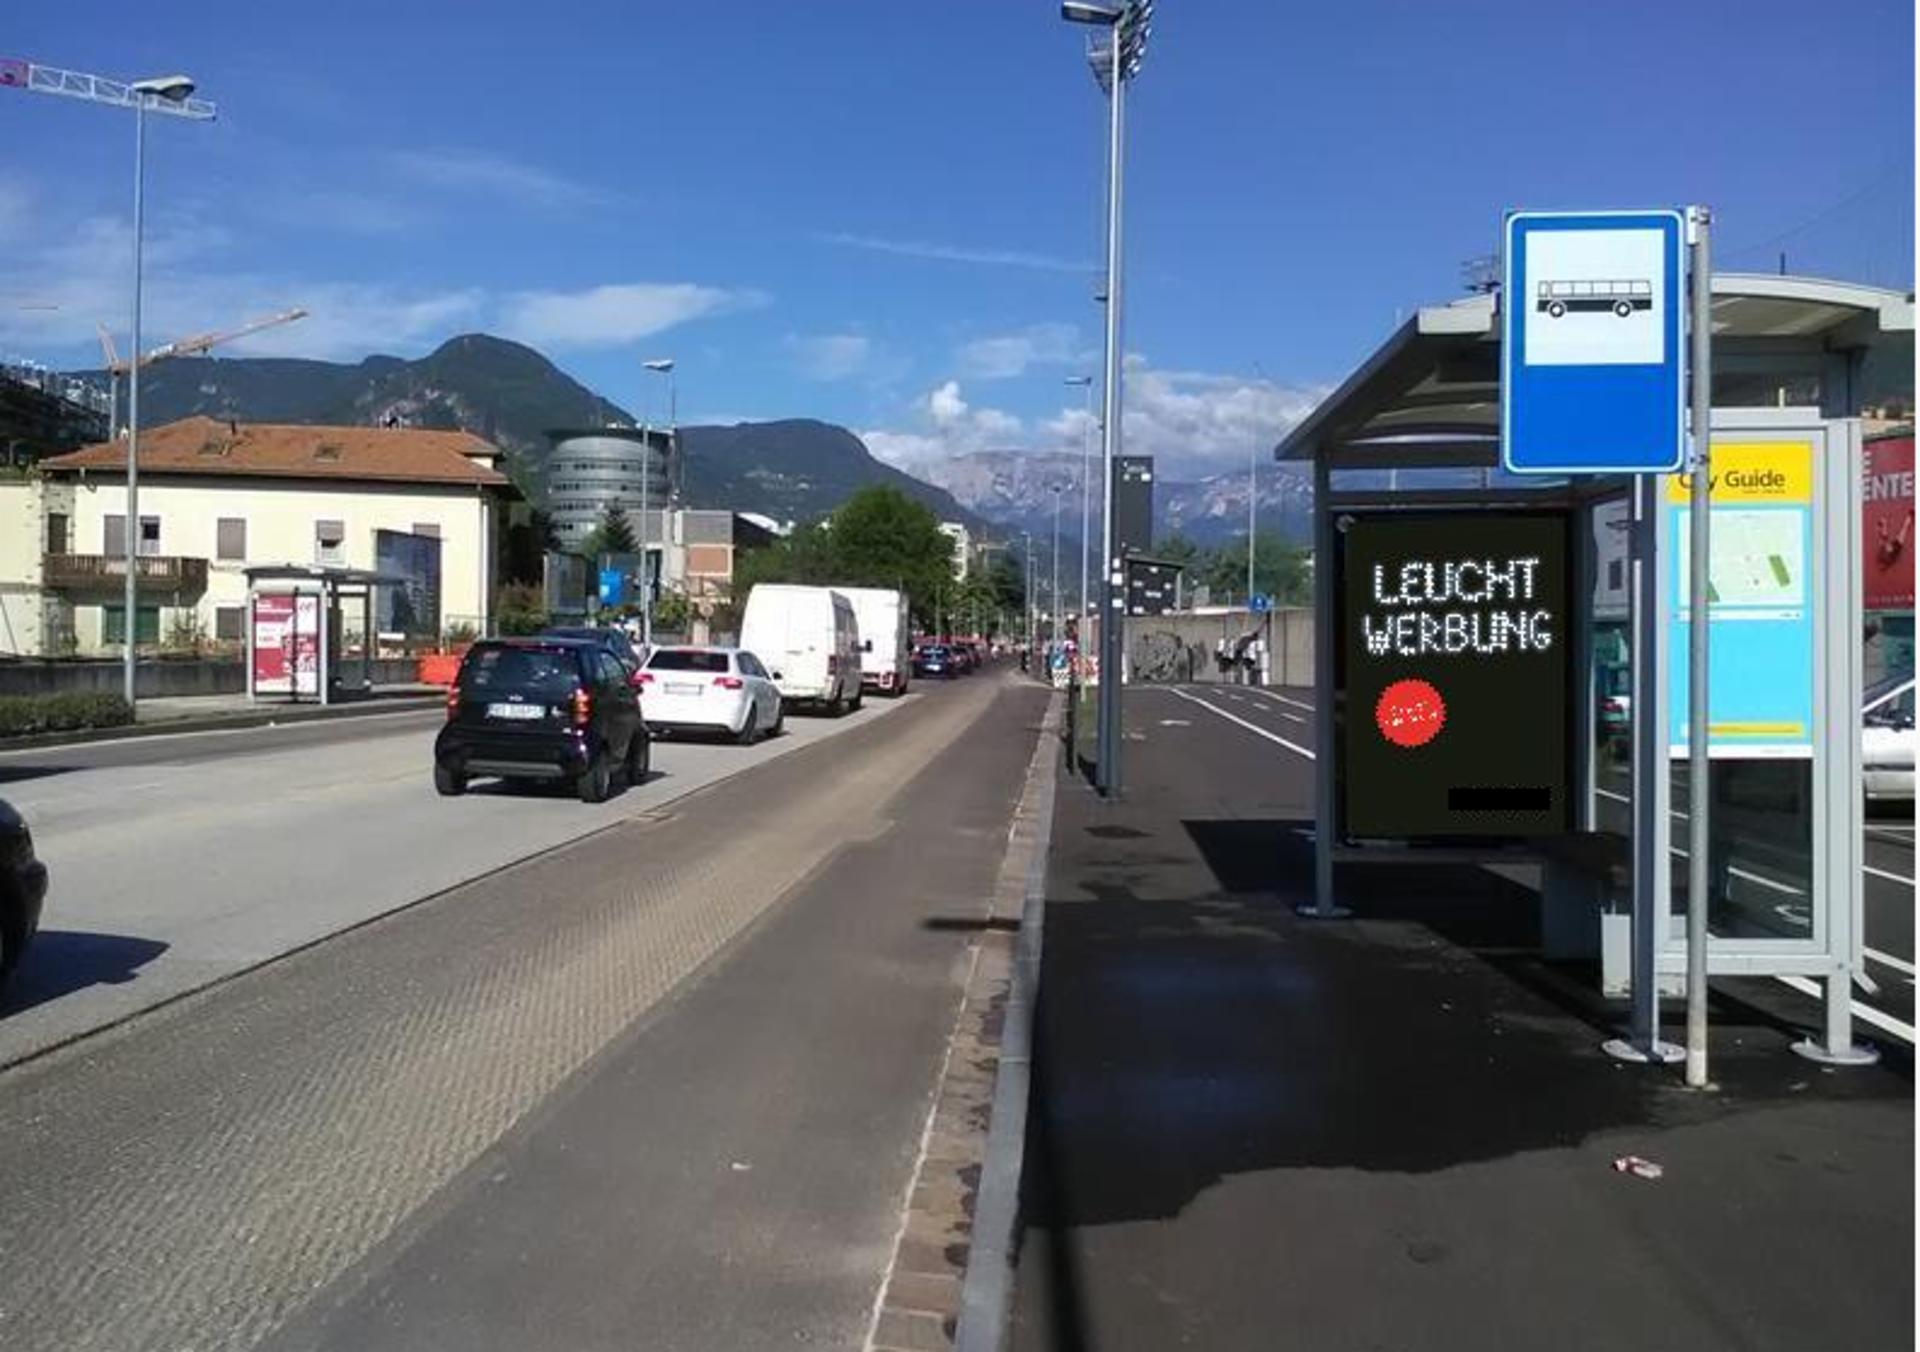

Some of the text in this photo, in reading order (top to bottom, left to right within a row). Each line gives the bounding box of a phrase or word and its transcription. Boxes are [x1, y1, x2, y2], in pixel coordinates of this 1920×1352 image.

[1724, 468, 1786, 488] Guide
[1374, 557, 1540, 604] LEUCHT
[1363, 610, 1552, 656] WERBUNG
